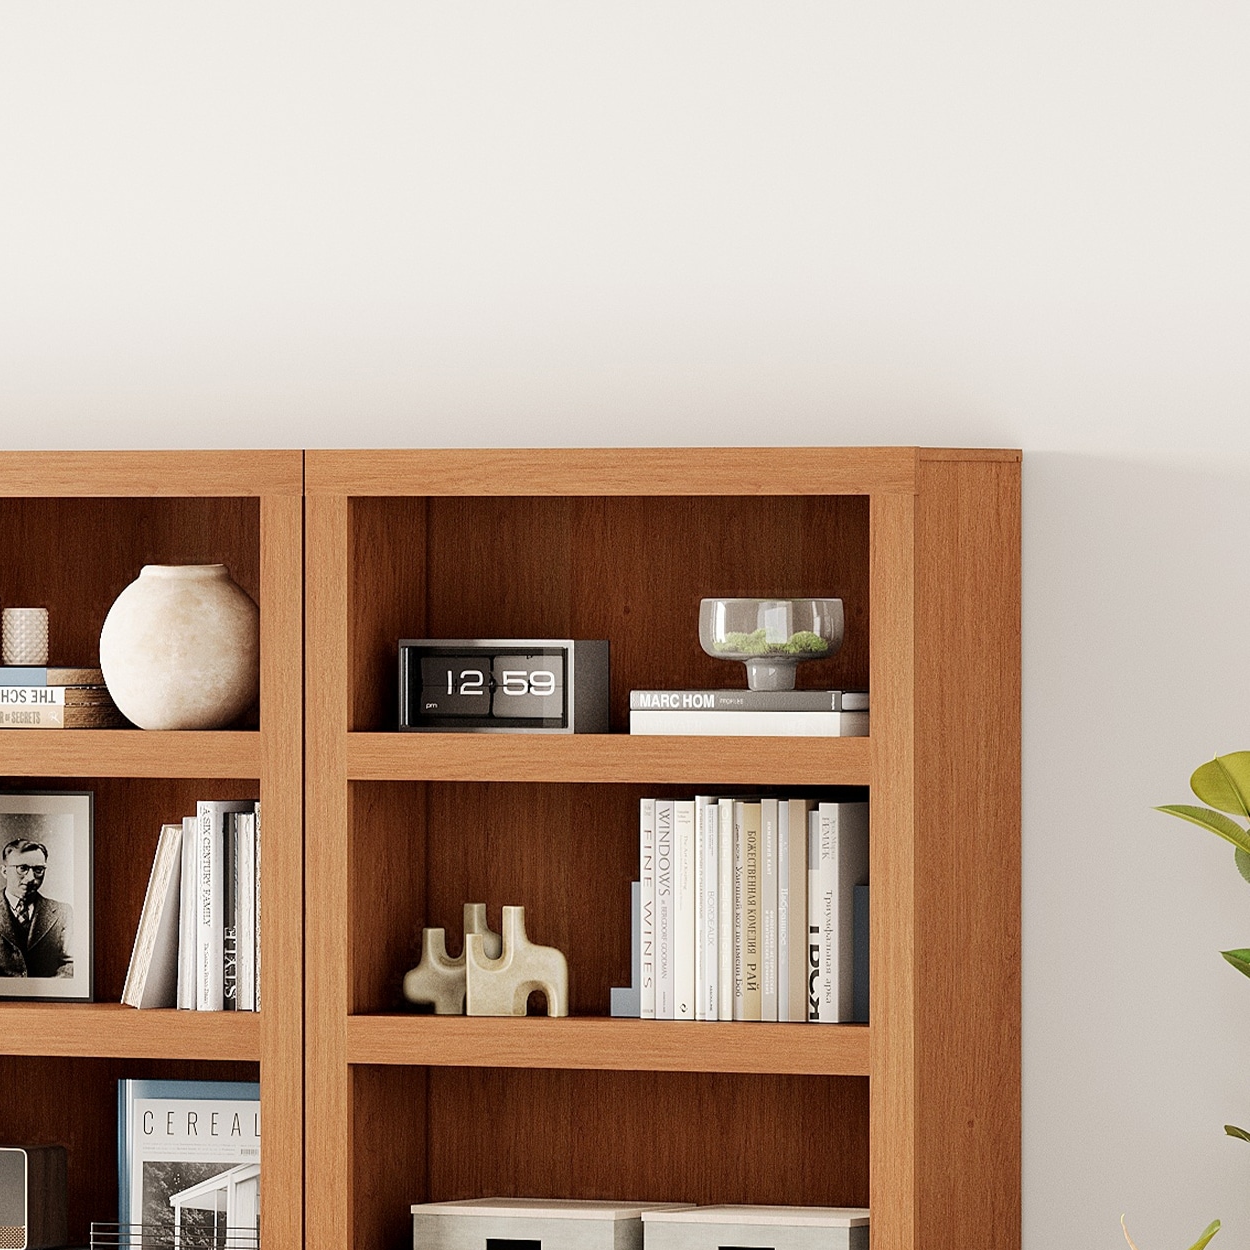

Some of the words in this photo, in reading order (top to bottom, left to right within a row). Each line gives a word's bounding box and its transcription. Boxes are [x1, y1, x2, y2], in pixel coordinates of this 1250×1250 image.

[31, 690, 56, 703] THE
[447, 670, 484, 695] 12
[502, 670, 555, 695] 59
[640, 693, 680, 708] MARC
[683, 694, 715, 708] HOM
[12, 711, 41, 724] SECRETS
[202, 807, 211, 816] A
[202, 817, 211, 835] SIX
[658, 808, 671, 896] WINDOWS
[821, 817, 830, 861] РЕМАРК
[202, 837, 211, 887] CENTURY
[644, 830, 652, 888] FINE
[747, 831, 757, 905] БОЖЕСТВЕННАЯ
[735, 866, 743, 910] Уличный
[202, 889, 211, 927] FAMILY
[707, 891, 715, 946] BORDEAUX
[643, 901, 652, 988] WINES
[735, 931, 741, 944] по
[746, 909, 756, 954] КОМЕДИЯ
[824, 890, 834, 974] Триумфальная
[224, 926, 236, 1000] STYLE
[746, 963, 760, 991] РАЙ
[735, 978, 743, 997] Боб
[824, 978, 832, 1004] арка
[143, 1110, 261, 1137] CEREAL
